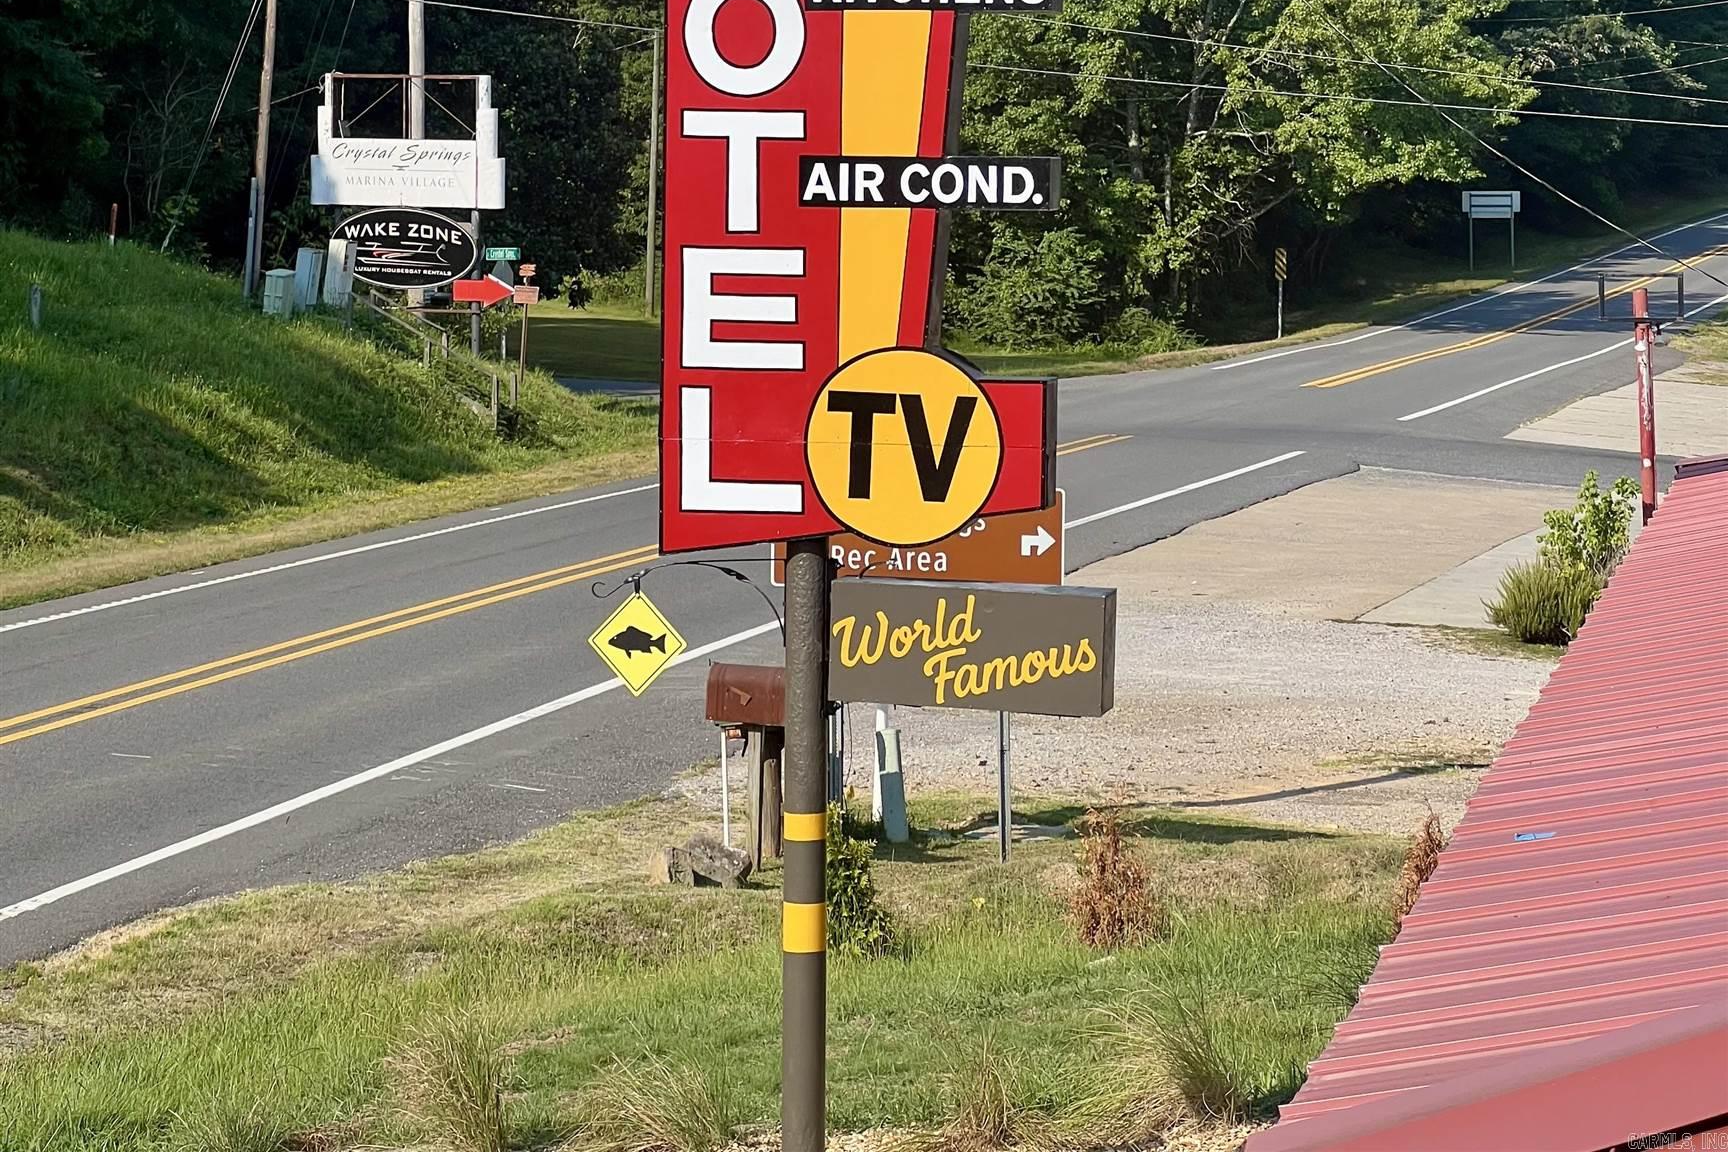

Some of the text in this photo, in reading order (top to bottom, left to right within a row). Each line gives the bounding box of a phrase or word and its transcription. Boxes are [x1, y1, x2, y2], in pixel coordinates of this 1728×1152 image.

[332, 142, 472, 166] Crystal Springs
[345, 175, 456, 188] MARINA VILLAGE
[802, 162, 1043, 204] AIR COND.
[344, 222, 463, 246] WAKE ZONE
[381, 267, 422, 275] HOUSEBOAT
[423, 269, 452, 277] RENTALS
[827, 390, 978, 503] TV
[831, 545, 948, 573] Rec Area
[832, 594, 982, 668] World
[923, 638, 1097, 705] Famous
